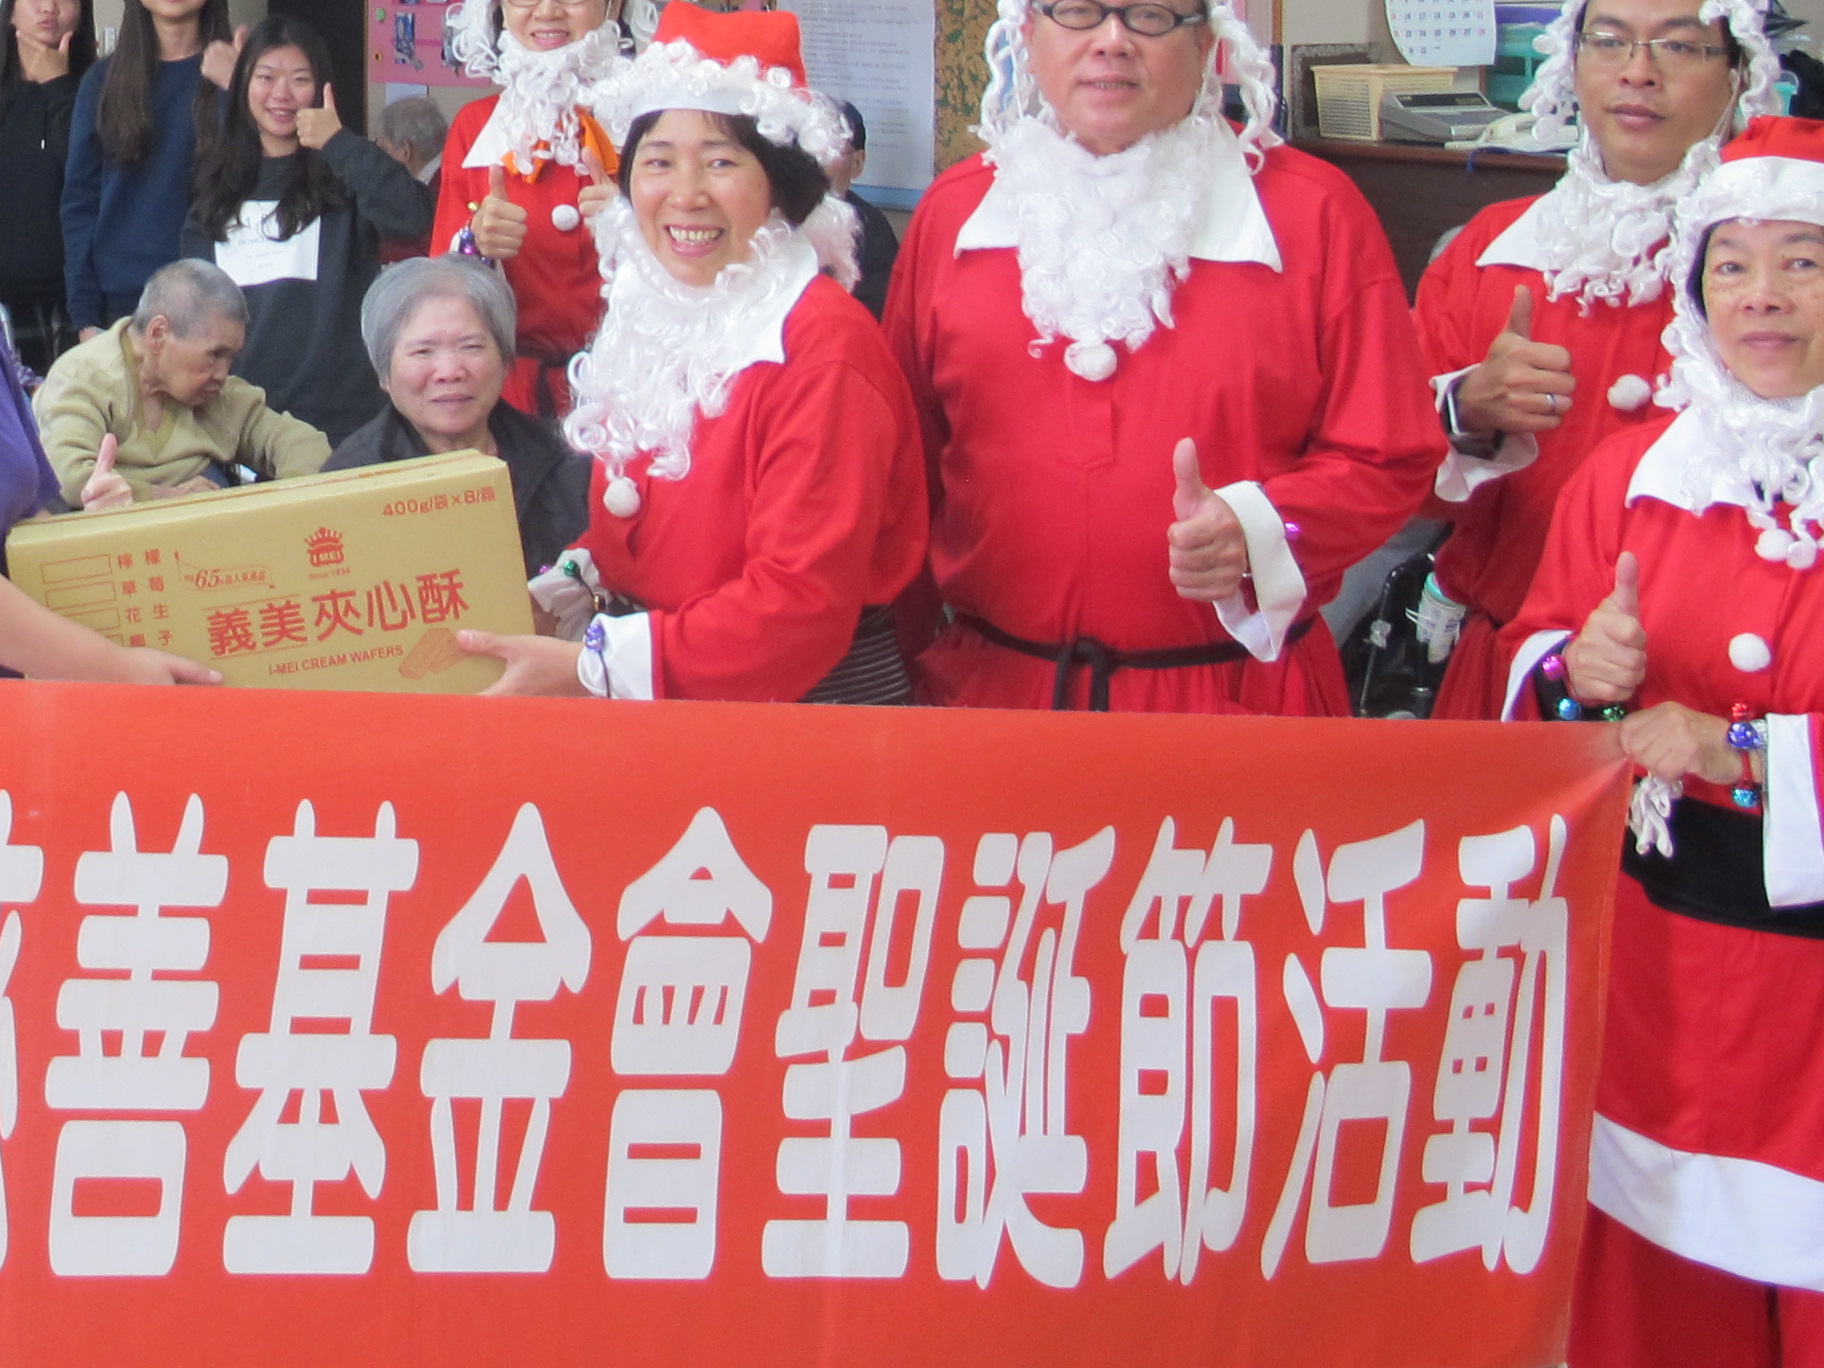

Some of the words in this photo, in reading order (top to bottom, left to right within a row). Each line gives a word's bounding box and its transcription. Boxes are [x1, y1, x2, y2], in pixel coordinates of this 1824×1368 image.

[126, 602, 170, 623] 花生
[207, 567, 469, 657] 義美夾心酥
[268, 661, 300, 676] I-MEI
[302, 653, 348, 672] CREAM
[351, 644, 404, 664] WAFERS
